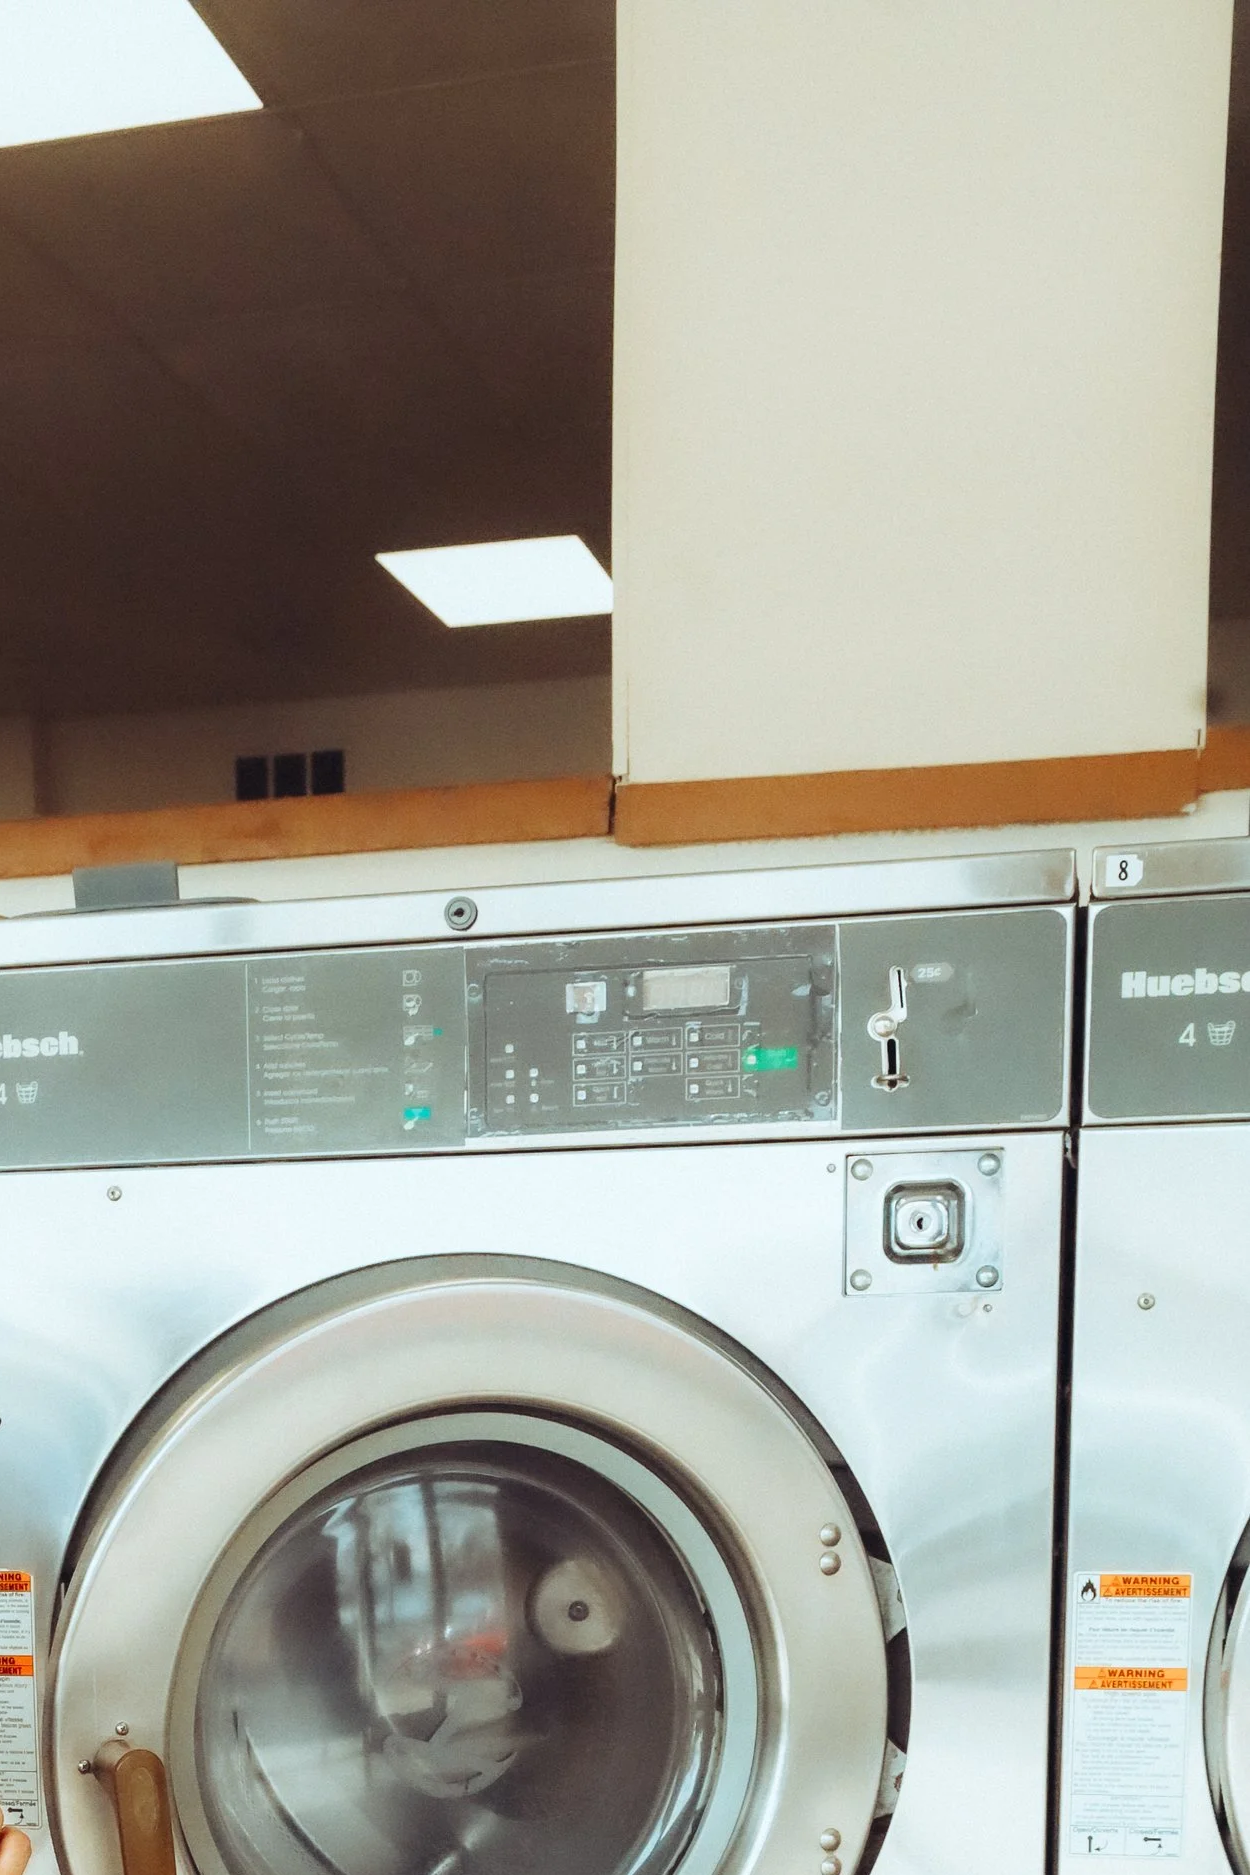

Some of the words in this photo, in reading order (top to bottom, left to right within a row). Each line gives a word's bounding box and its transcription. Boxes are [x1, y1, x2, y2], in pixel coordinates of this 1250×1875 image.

[1118, 859, 1129, 881] 8
[917, 966, 941, 980] 25¢
[1178, 1022, 1197, 1048] 4
[1122, 1576, 1180, 1585] WARNING
[1115, 1587, 1187, 1597] AVERTISSEMENT
[1108, 1668, 1165, 1678] WARNING
[1100, 1680, 1173, 1689] AVERTISSEMENT
